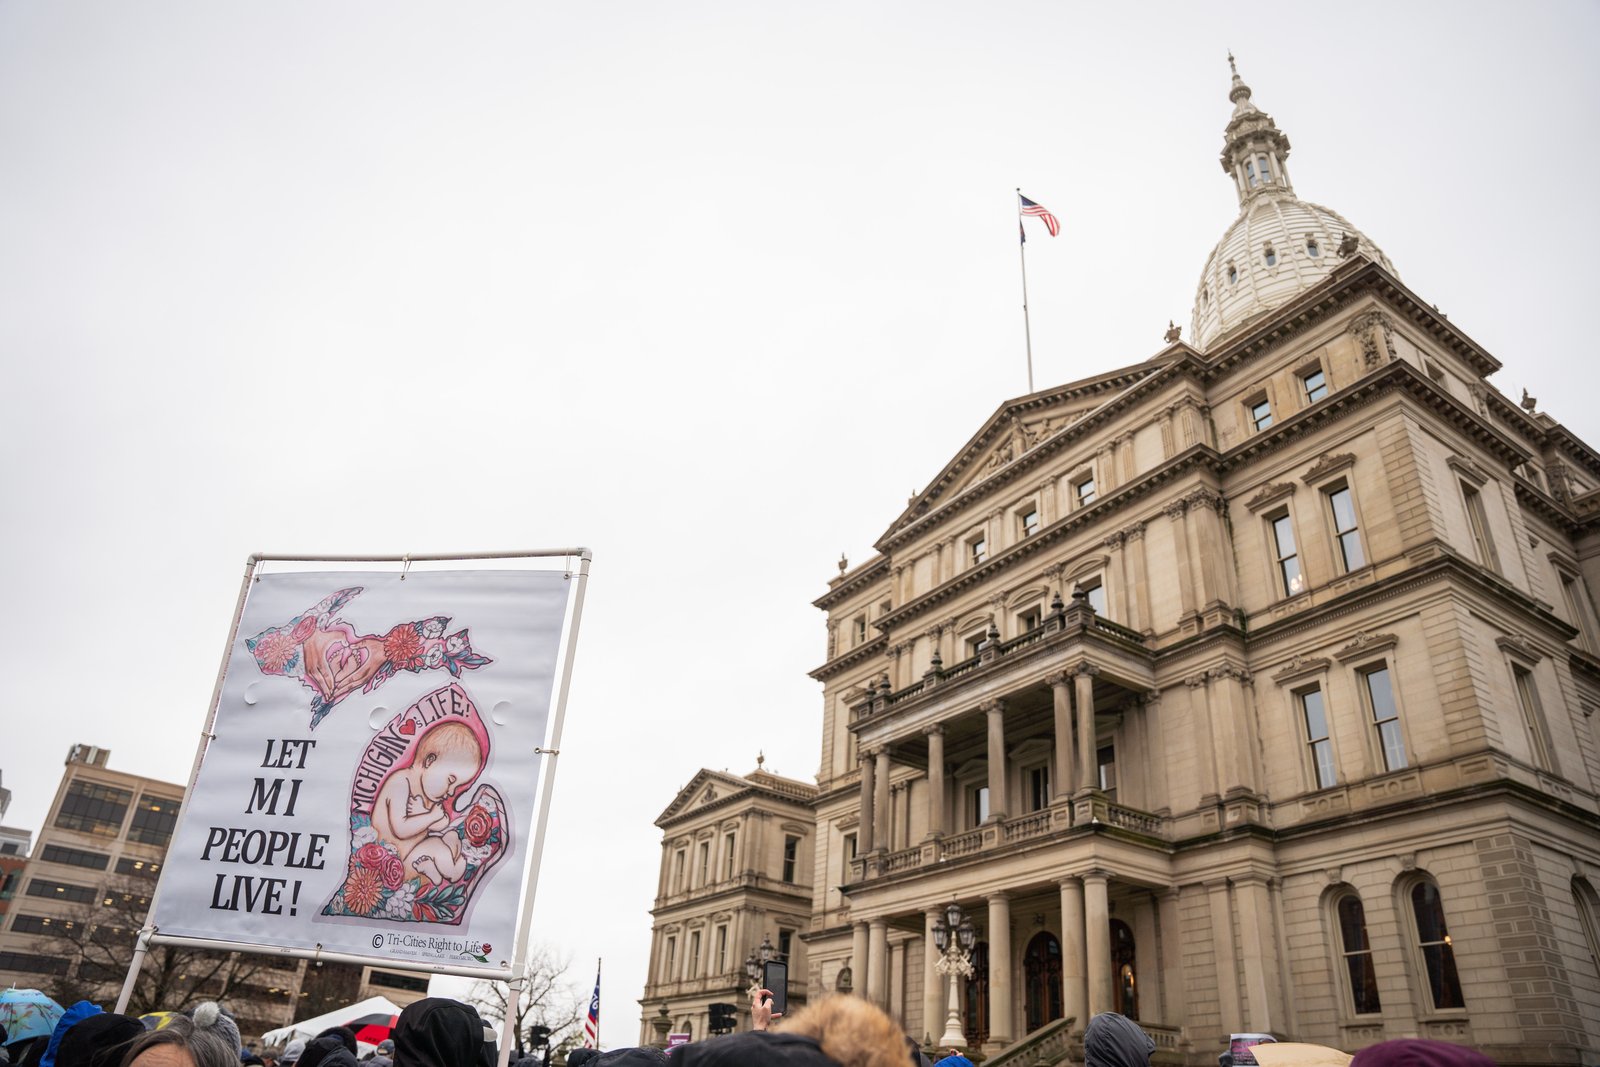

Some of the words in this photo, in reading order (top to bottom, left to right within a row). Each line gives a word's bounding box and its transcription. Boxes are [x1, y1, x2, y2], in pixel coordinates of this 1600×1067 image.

[260, 739, 317, 769] LET
[352, 723, 411, 816] MICHIGAN
[415, 688, 470, 727] LIFE!
[244, 777, 303, 817] MI
[200, 826, 330, 870] PEOPLE
[209, 873, 303, 917] LIVE!
[387, 933, 427, 948] Tri-Cities
[428, 936, 451, 953] Right
[452, 940, 462, 950] to
[464, 939, 482, 953] Life
